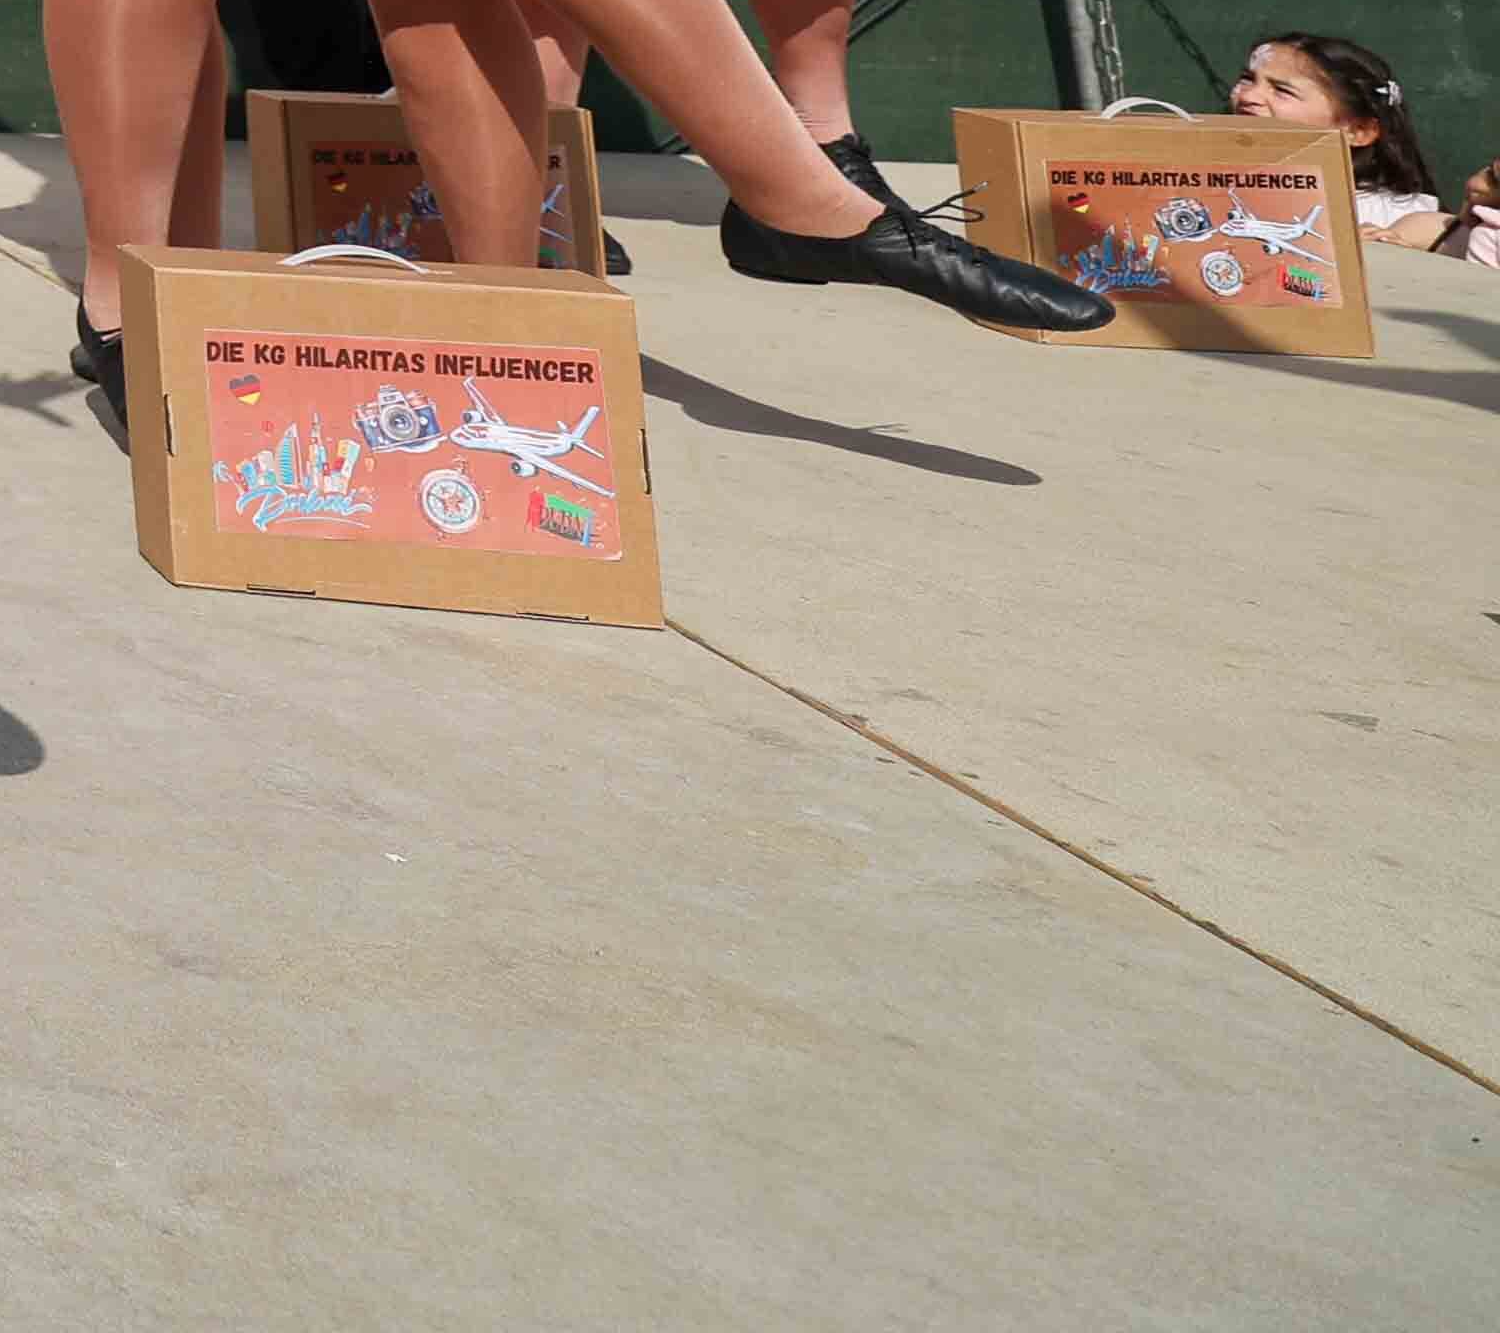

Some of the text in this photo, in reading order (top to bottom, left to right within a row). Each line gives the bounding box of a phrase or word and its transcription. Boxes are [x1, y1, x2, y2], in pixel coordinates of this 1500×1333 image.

[1051, 170, 1318, 190] DIE KG HILARITAS INFLUENCER
[206, 341, 594, 384] DIE KG HILARITAS INFLUENCER
